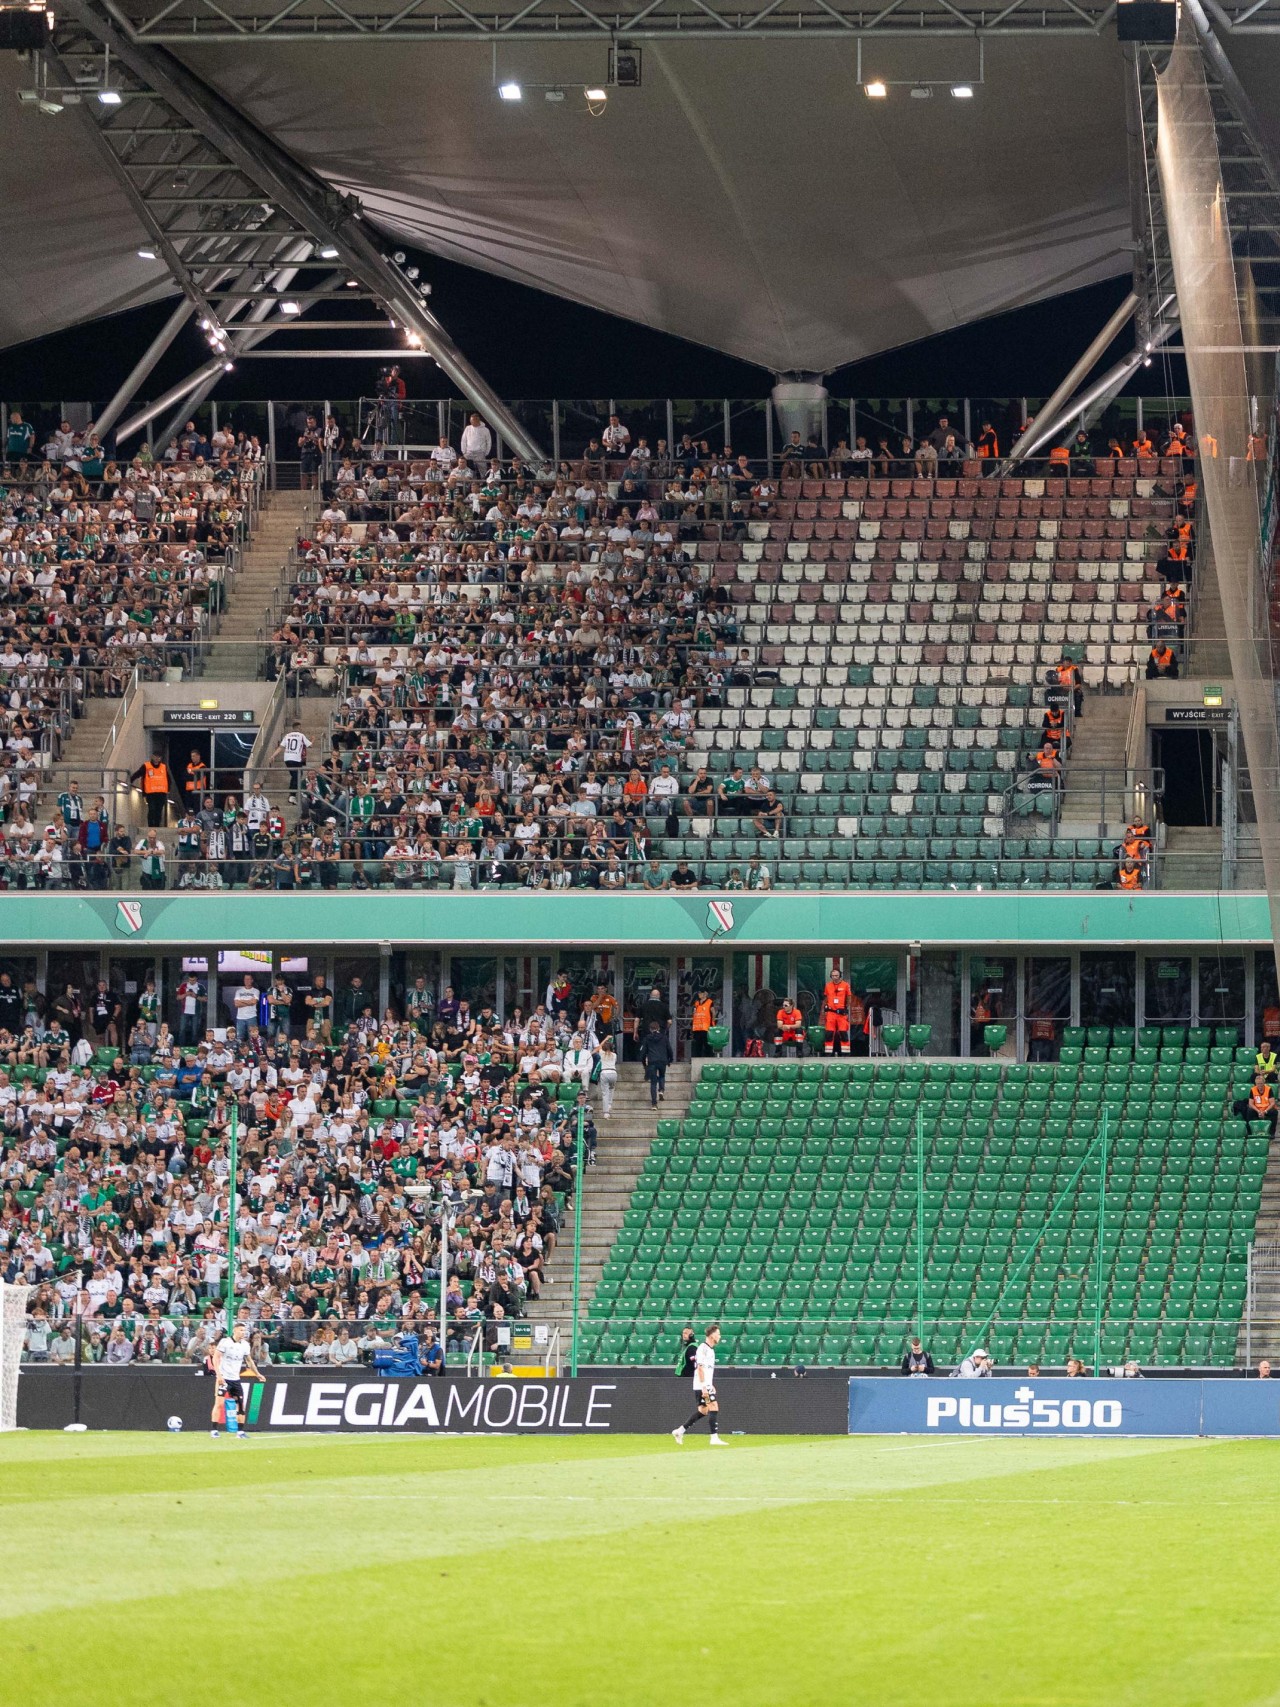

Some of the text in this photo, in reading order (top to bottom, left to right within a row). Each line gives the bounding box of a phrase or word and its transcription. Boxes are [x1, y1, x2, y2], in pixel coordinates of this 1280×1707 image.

[1172, 710, 1206, 718] WYJŚCIE
[287, 738, 298, 751] 10
[270, 1383, 617, 1427] LEGIA MOBILE
[926, 1396, 1123, 1428] Plus500
